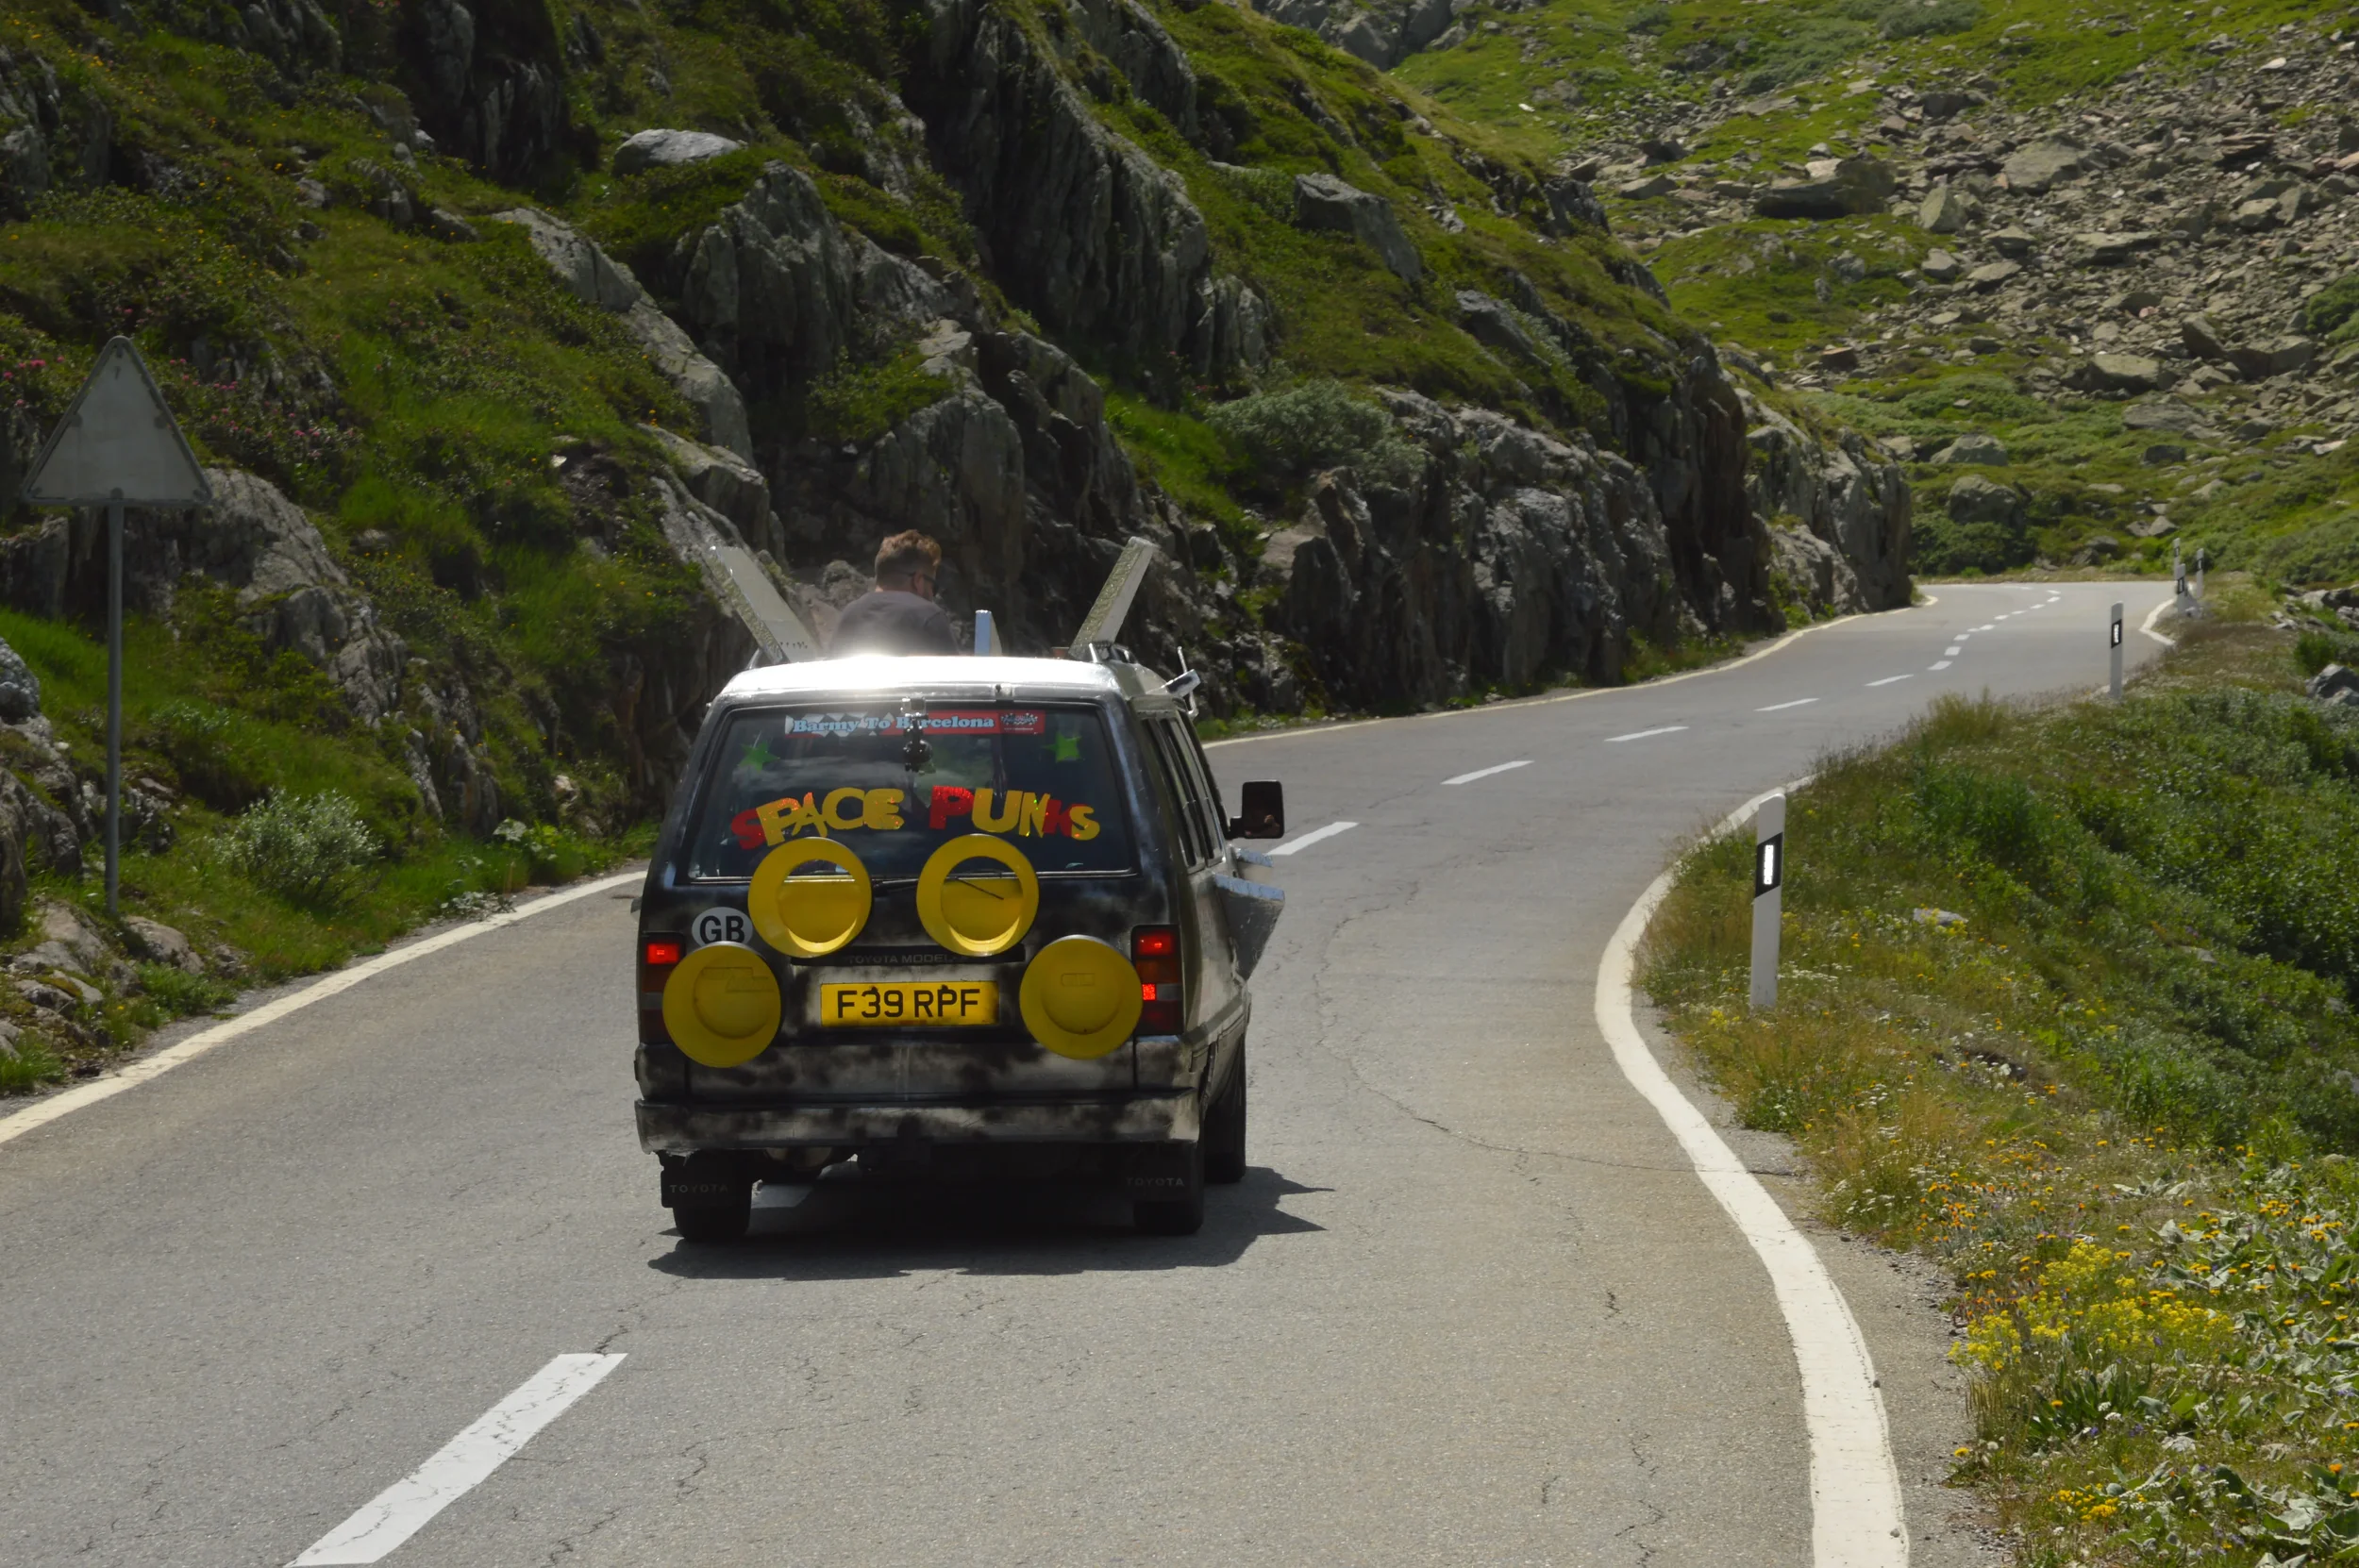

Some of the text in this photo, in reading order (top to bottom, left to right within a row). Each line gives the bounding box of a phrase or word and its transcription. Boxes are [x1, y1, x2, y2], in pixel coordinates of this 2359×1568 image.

[793, 719, 860, 733] Barmy
[865, 716, 892, 729] To
[895, 716, 995, 729] Brcelona
[731, 787, 905, 849] SPACE
[699, 915, 745, 944] GB
[838, 988, 981, 1019] F39 RPF
[669, 1184, 728, 1193] TOYOTA
[1125, 1176, 1186, 1187] TOYOTA
